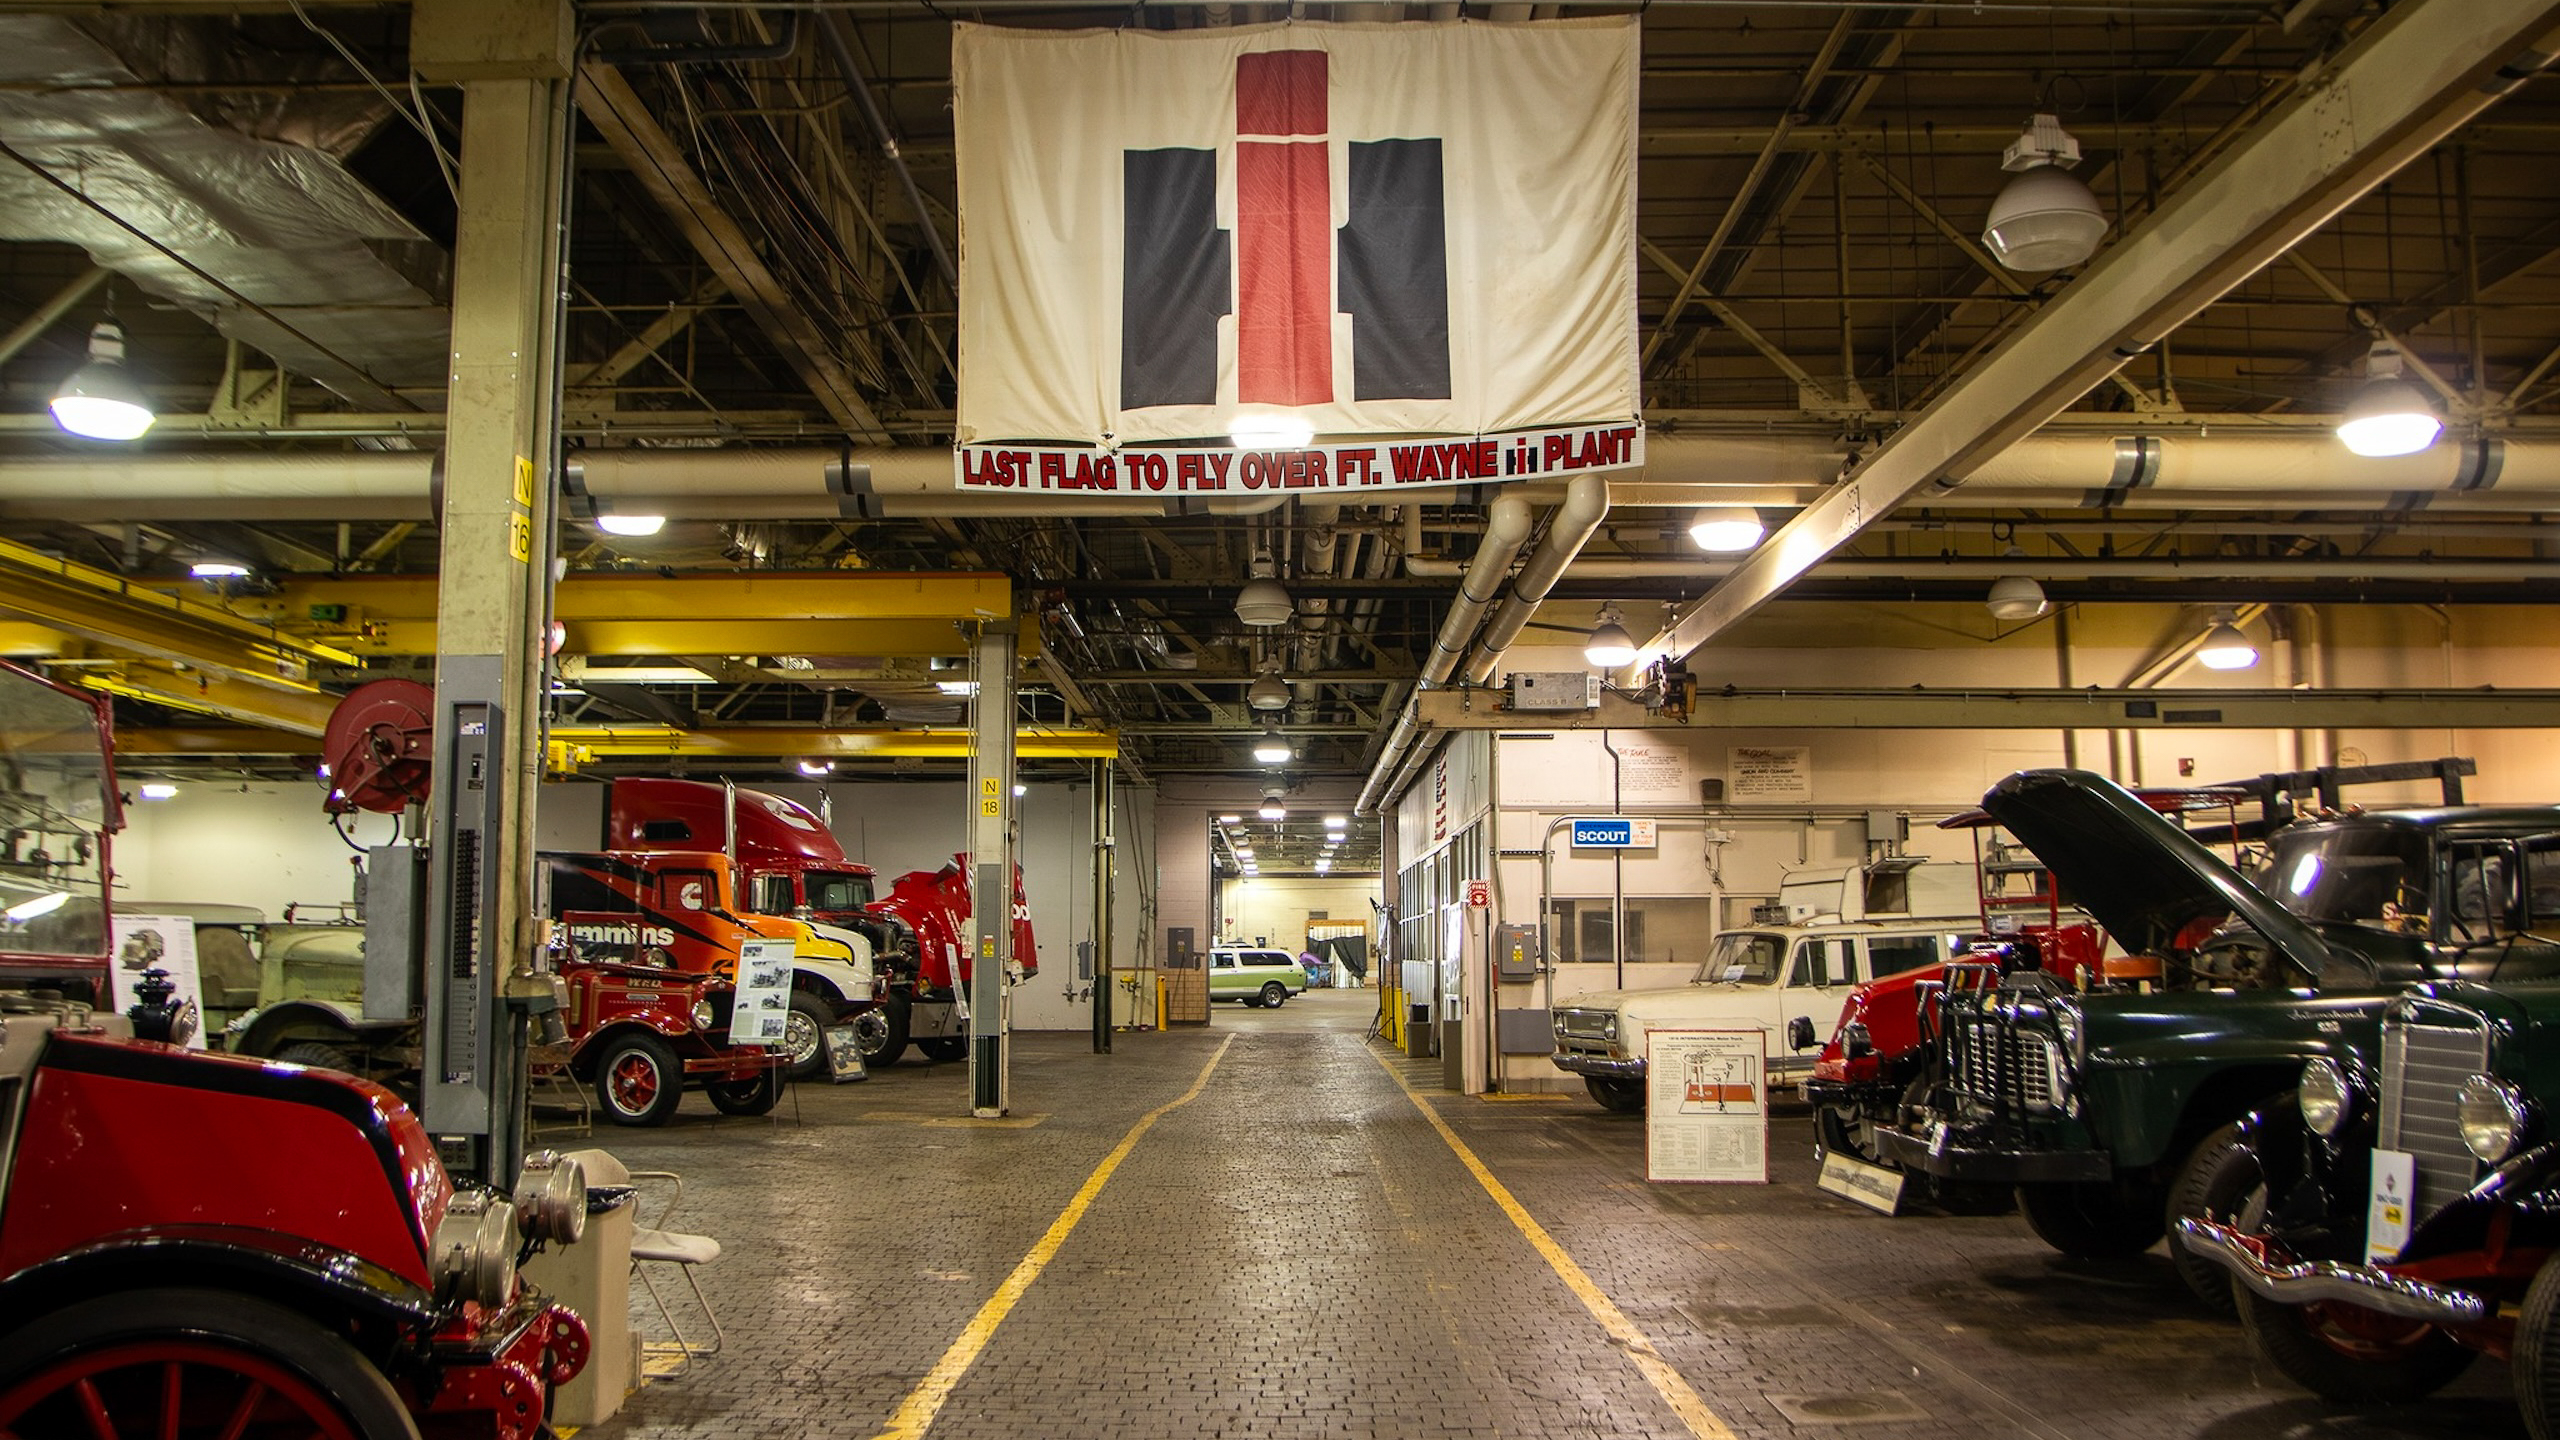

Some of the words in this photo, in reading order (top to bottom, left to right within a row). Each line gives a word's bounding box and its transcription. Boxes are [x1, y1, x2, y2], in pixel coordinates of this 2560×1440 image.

[962, 449, 1031, 488] LAST
[1039, 452, 1117, 490] FLAG
[1124, 453, 1168, 491] TO
[1177, 453, 1233, 491] FLY
[1240, 450, 1329, 491] OVER
[1336, 448, 1382, 486] FT.
[1389, 441, 1498, 483] WAYNE
[1543, 427, 1637, 471] PLANT
[518, 464, 530, 500] N
[513, 521, 529, 554] 16
[1528, 698, 1558, 706] CLASS
[985, 780, 996, 793] N
[984, 801, 998, 814] 18
[1576, 830, 1628, 842] SCOUT
